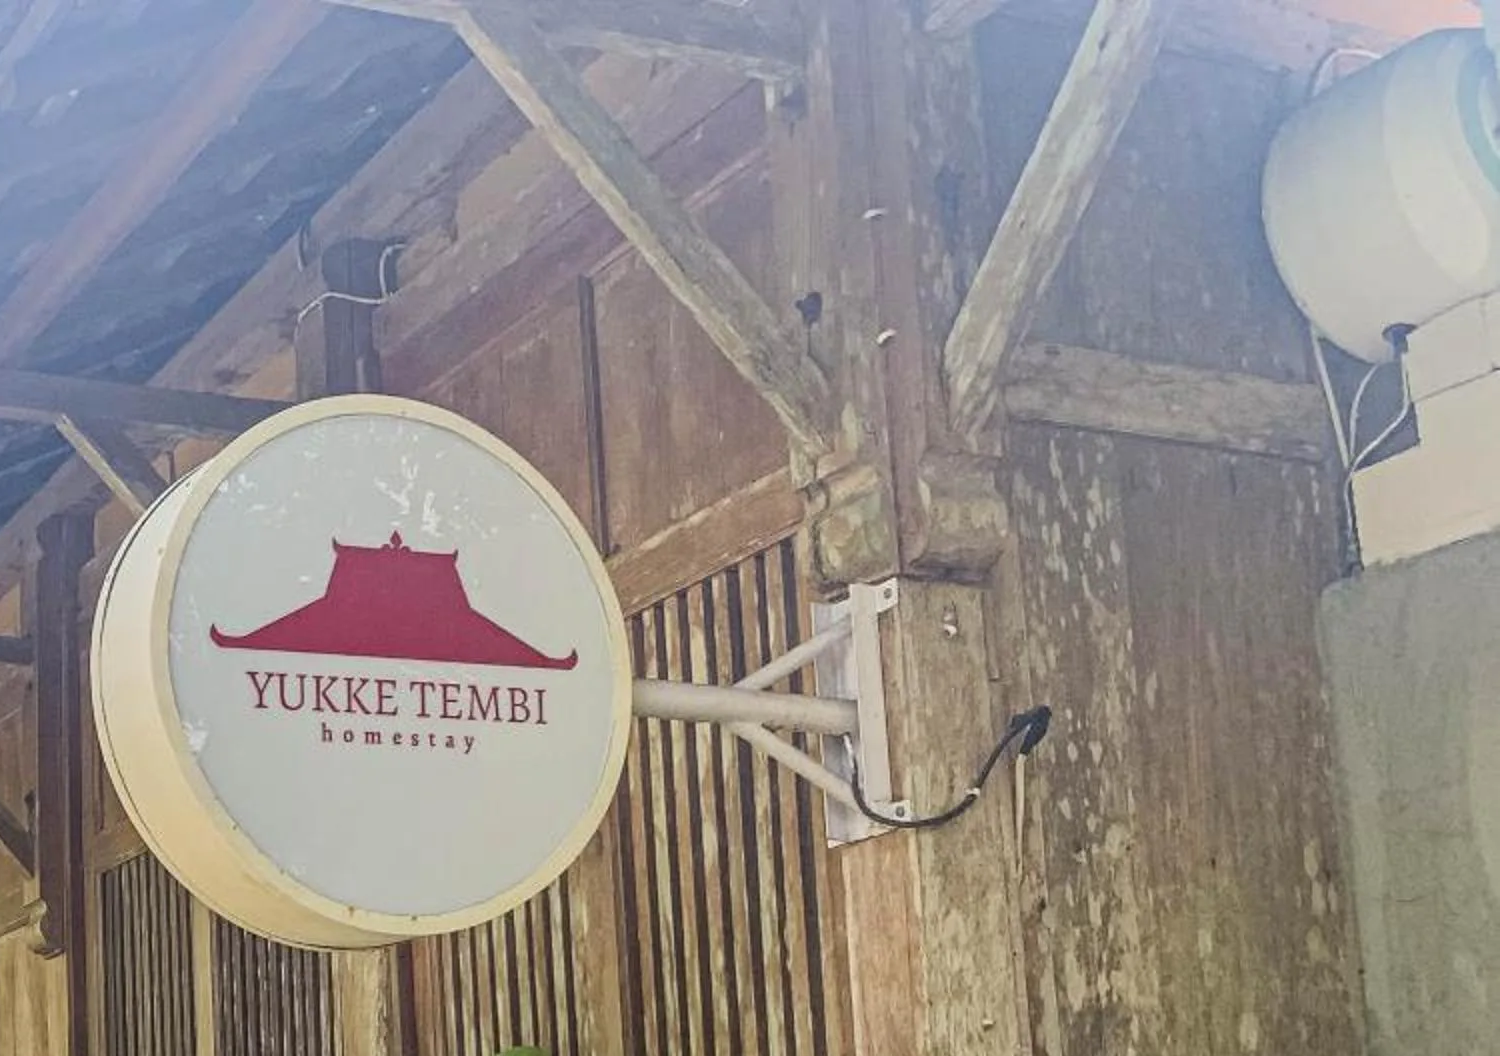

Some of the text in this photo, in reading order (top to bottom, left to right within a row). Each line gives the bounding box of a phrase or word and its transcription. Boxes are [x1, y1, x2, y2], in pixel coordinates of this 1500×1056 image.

[246, 671, 548, 725] YUKKE TEMBI
[321, 722, 475, 754] homestay
